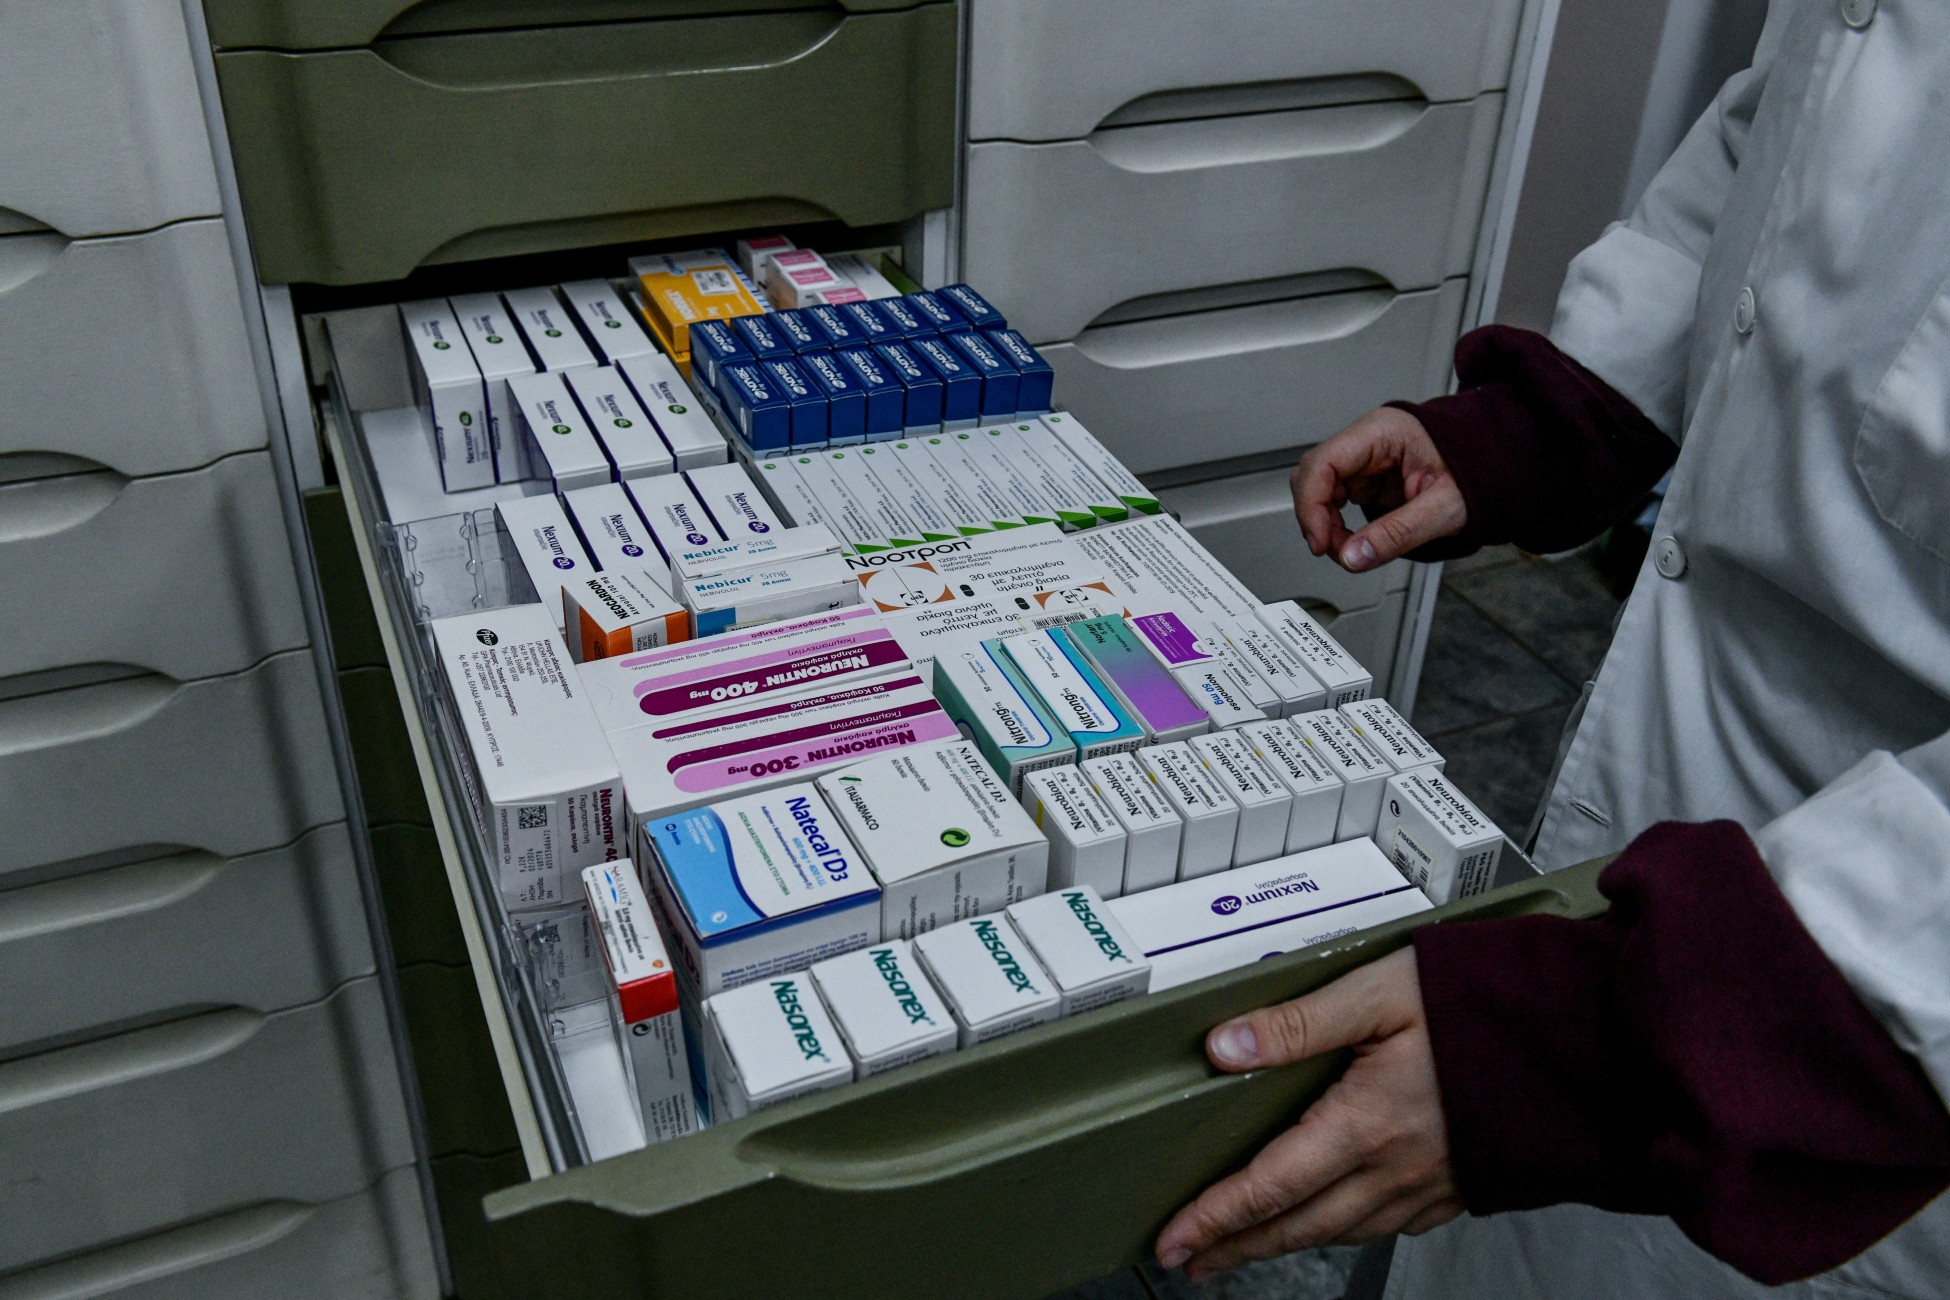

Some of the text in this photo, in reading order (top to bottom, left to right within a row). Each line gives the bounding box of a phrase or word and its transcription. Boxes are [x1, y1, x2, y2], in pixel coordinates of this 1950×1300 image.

[672, 503, 696, 533] Nexium
[733, 492, 758, 522] Nexium
[542, 526, 564, 556] Nexium
[609, 514, 632, 544] Nexium
[683, 544, 738, 560] Nebicur
[688, 555, 727, 566] NEBIVOLOL
[694, 570, 789, 591] Nebicur 5mg
[968, 559, 1064, 582] 30 επικαλυμμένα
[992, 571, 1045, 587] με λεπτό
[996, 573, 1070, 592] υμένιο δισκία
[586, 580, 630, 619] NEOCARDON
[700, 587, 741, 598] NEBIVOLOL
[916, 602, 993, 621] υμένιο δισκία
[920, 617, 1003, 637] επικαλυμμένα
[943, 608, 998, 624] με λεπτό
[1005, 613, 1021, 621] 30
[751, 628, 784, 638] σκληρά
[788, 637, 856, 656] Γκαμπαπεντίνη
[1300, 621, 1339, 657] Neurobion
[791, 648, 864, 668] σκληρά καψάκια
[1244, 639, 1280, 675] Neurobion
[689, 654, 870, 701] NEURONTIN 400 mg
[827, 688, 872, 701] Καψάκια,
[1202, 683, 1224, 706] 50 mg
[1205, 673, 1241, 712] Normolose
[790, 698, 826, 709] σκληρά
[830, 711, 901, 730] Γκαμπαπεντίνη
[1064, 694, 1098, 730] Nitrong
[834, 723, 910, 743] σκληρά καψάκια
[996, 708, 1029, 745] Nitrong
[1362, 711, 1408, 756] Neurobion
[728, 730, 916, 777] NEURONTIN 300 mg
[1262, 733, 1305, 779] Neurobion
[1312, 722, 1357, 768] Neurobion
[957, 746, 1007, 803] NATECAL D3
[1157, 757, 1199, 806] Neurobion
[1211, 745, 1253, 792] Neurobion
[844, 786, 879, 831] ITALFARMACO
[1046, 780, 1086, 830] Neurobion
[1102, 768, 1142, 817] Neurobion
[1428, 778, 1480, 827] Neurobion
[600, 788, 614, 844] NEURONTIN
[785, 797, 848, 881] Natecal D3
[1220, 880, 1320, 912] Nexium 20
[1062, 892, 1127, 961] Nasonex
[970, 920, 1035, 994] Nasonex
[869, 949, 931, 1024] Nasonex
[770, 981, 825, 1060] Nasonex
